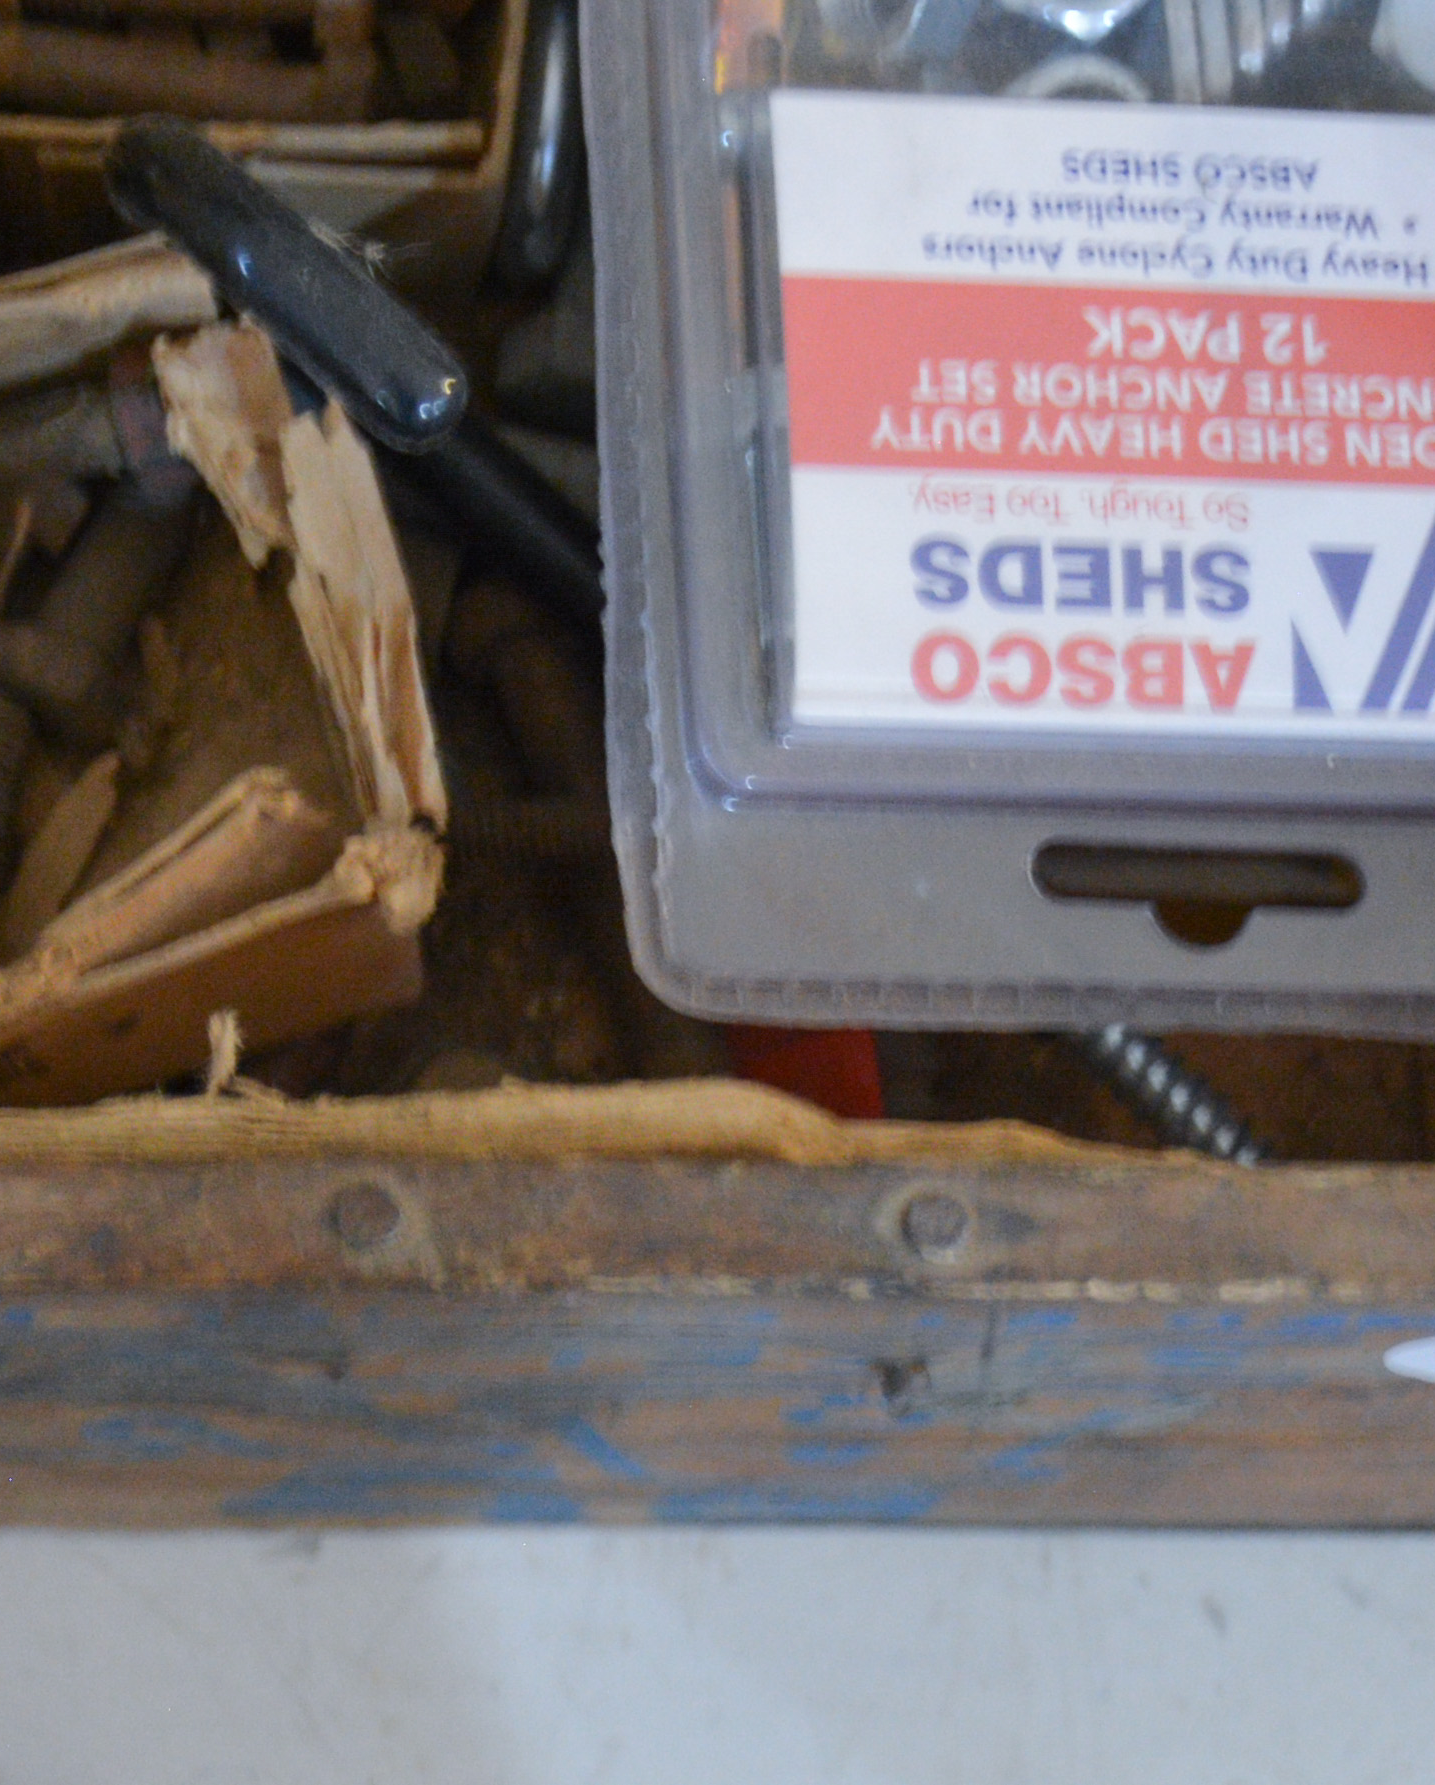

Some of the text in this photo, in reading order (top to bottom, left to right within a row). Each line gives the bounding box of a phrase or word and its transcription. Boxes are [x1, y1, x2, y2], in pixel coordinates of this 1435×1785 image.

[1061, 149, 1319, 194] ABSCO SHEDS
[966, 190, 1379, 240] Warranty Compliant for
[922, 233, 1429, 287] Heavy Duty Cyclone Anchors
[1083, 305, 1329, 366] 12 PACK
[911, 358, 999, 406] SET
[1011, 361, 1228, 413] ANCHOR
[871, 405, 1003, 455] DUTY
[1018, 414, 1183, 461] HEAVY
[1197, 416, 1332, 467] SHED
[1007, 487, 1070, 527] Too
[1203, 491, 1250, 533] So
[909, 534, 1251, 622] SHEDS
[909, 631, 1256, 715] ABSCO
